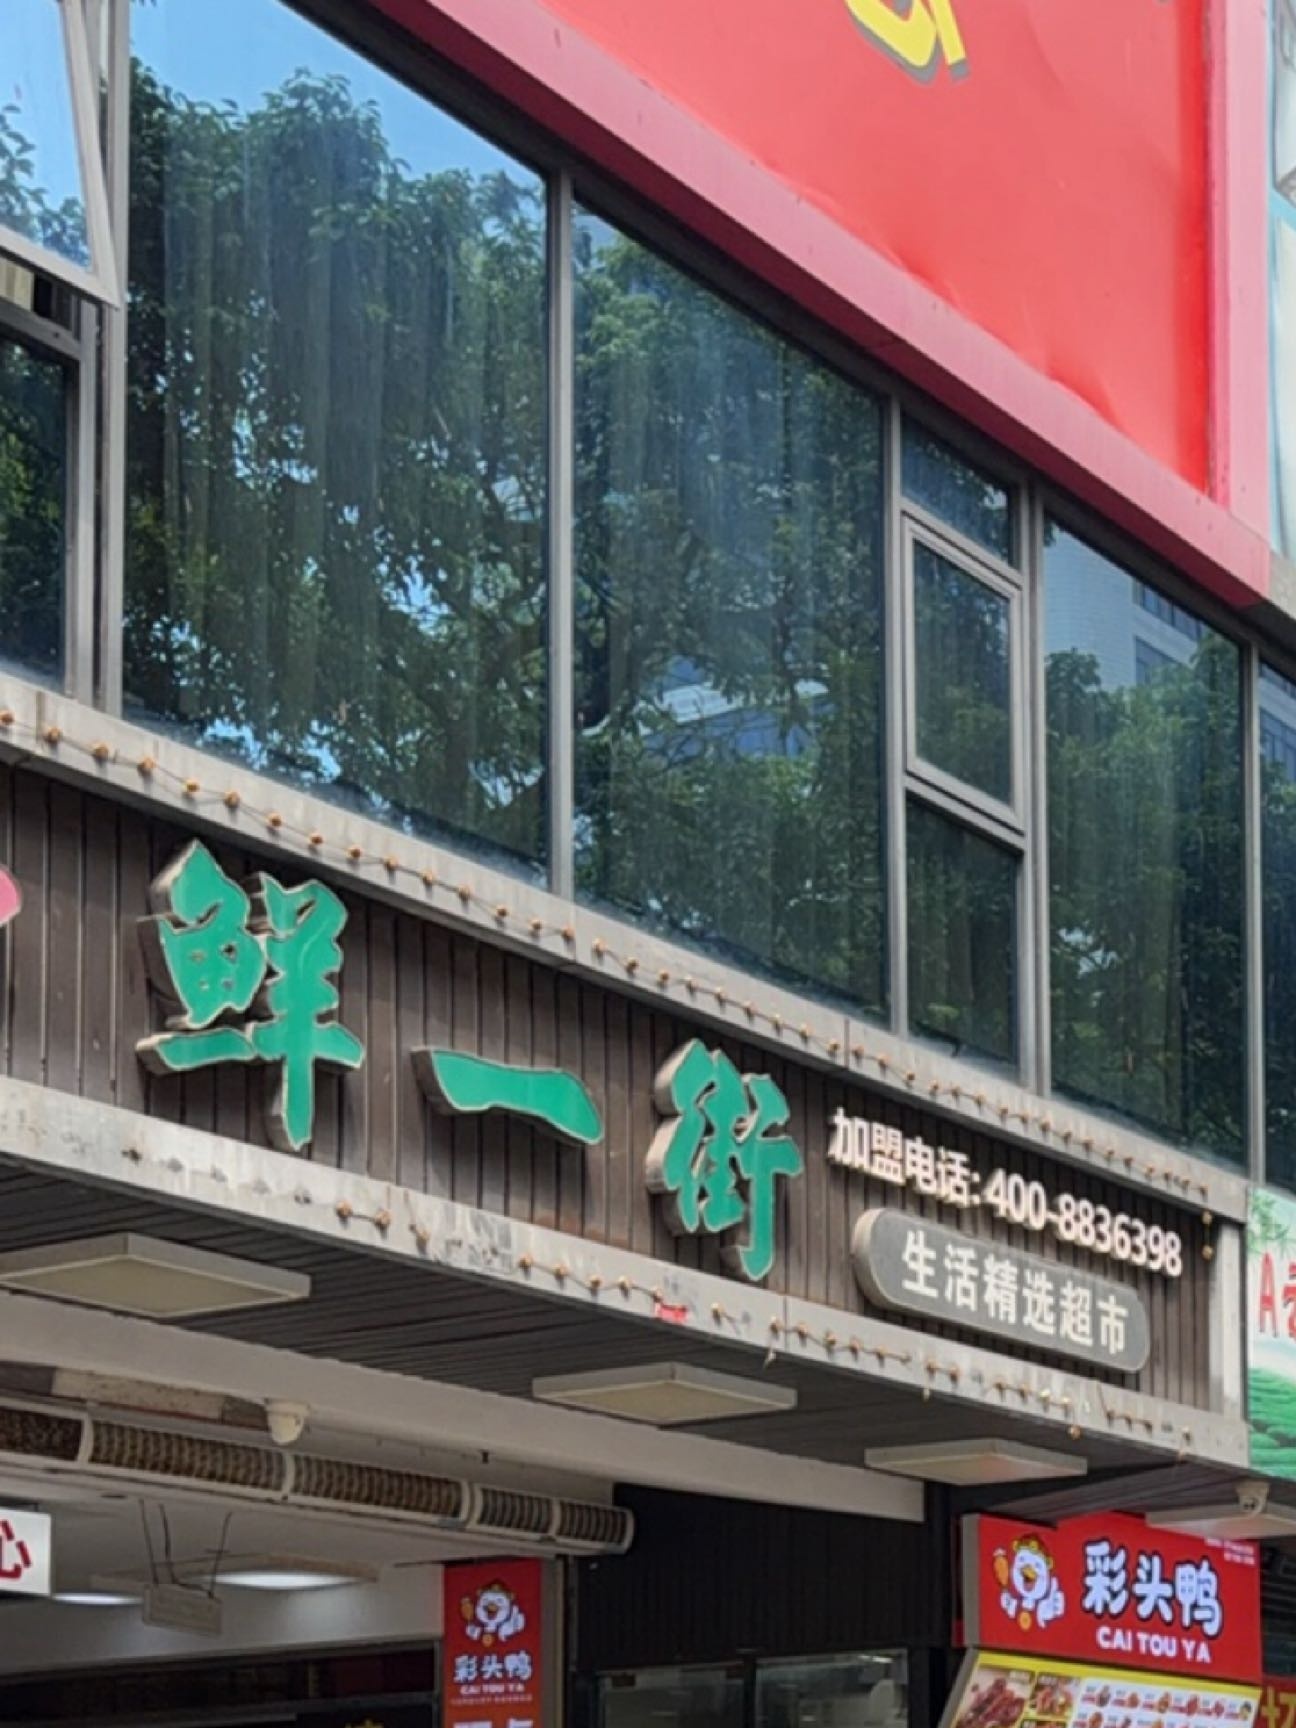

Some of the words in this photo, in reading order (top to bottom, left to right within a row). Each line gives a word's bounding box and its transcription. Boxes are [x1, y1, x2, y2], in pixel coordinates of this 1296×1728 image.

[902, 1229, 1128, 1355] 生活精选超市
[1083, 1538, 1224, 1637] 彩头鸭
[454, 1651, 532, 1684] 彩头鸭
[1096, 1626, 1133, 1652] CAI
[1138, 1631, 1177, 1657] TOU
